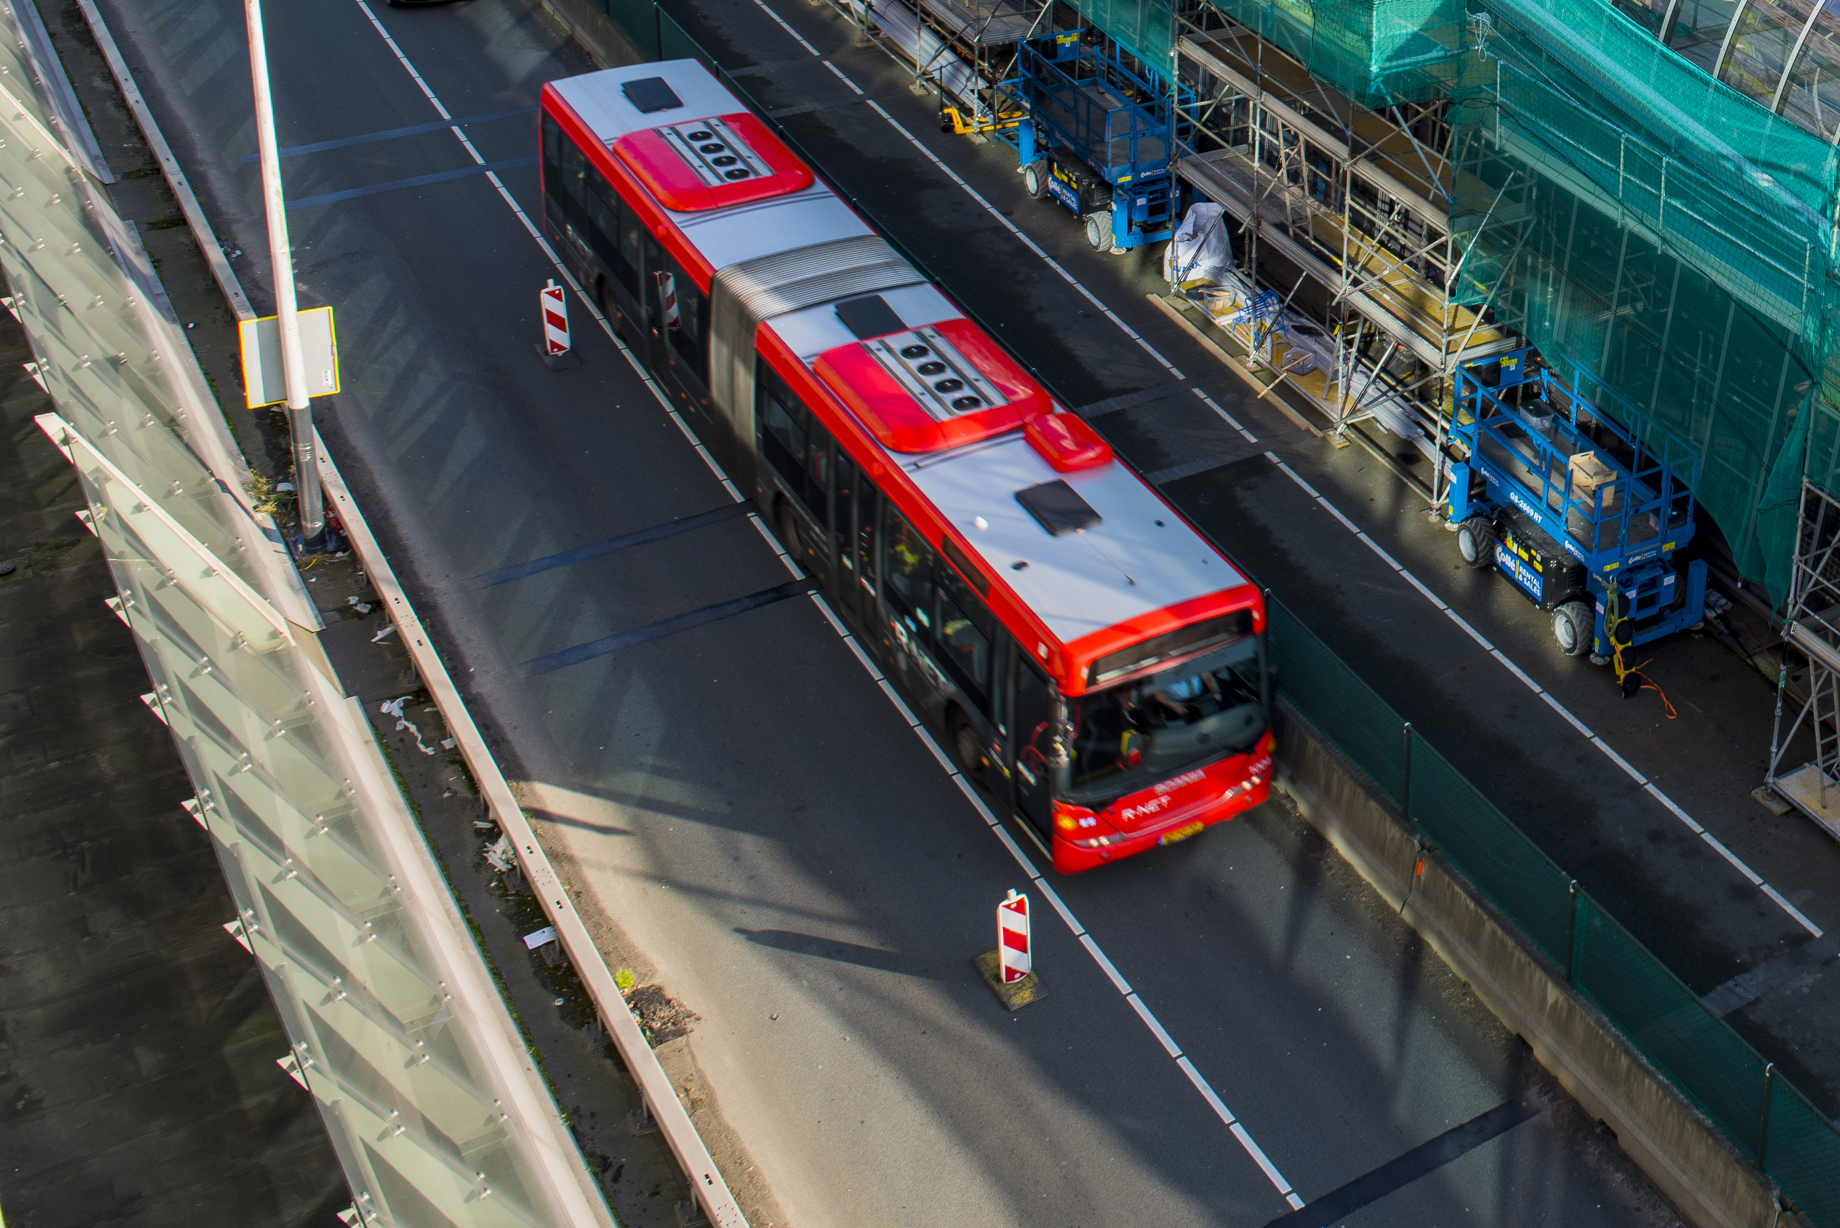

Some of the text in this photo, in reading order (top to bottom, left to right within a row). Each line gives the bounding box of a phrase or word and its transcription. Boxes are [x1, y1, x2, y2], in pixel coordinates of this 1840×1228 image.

[1533, 512, 1543, 524] RT
[1494, 543, 1516, 572] Collé
[1519, 565, 1541, 588] RENTAL
[1524, 577, 1541, 597] SALES
